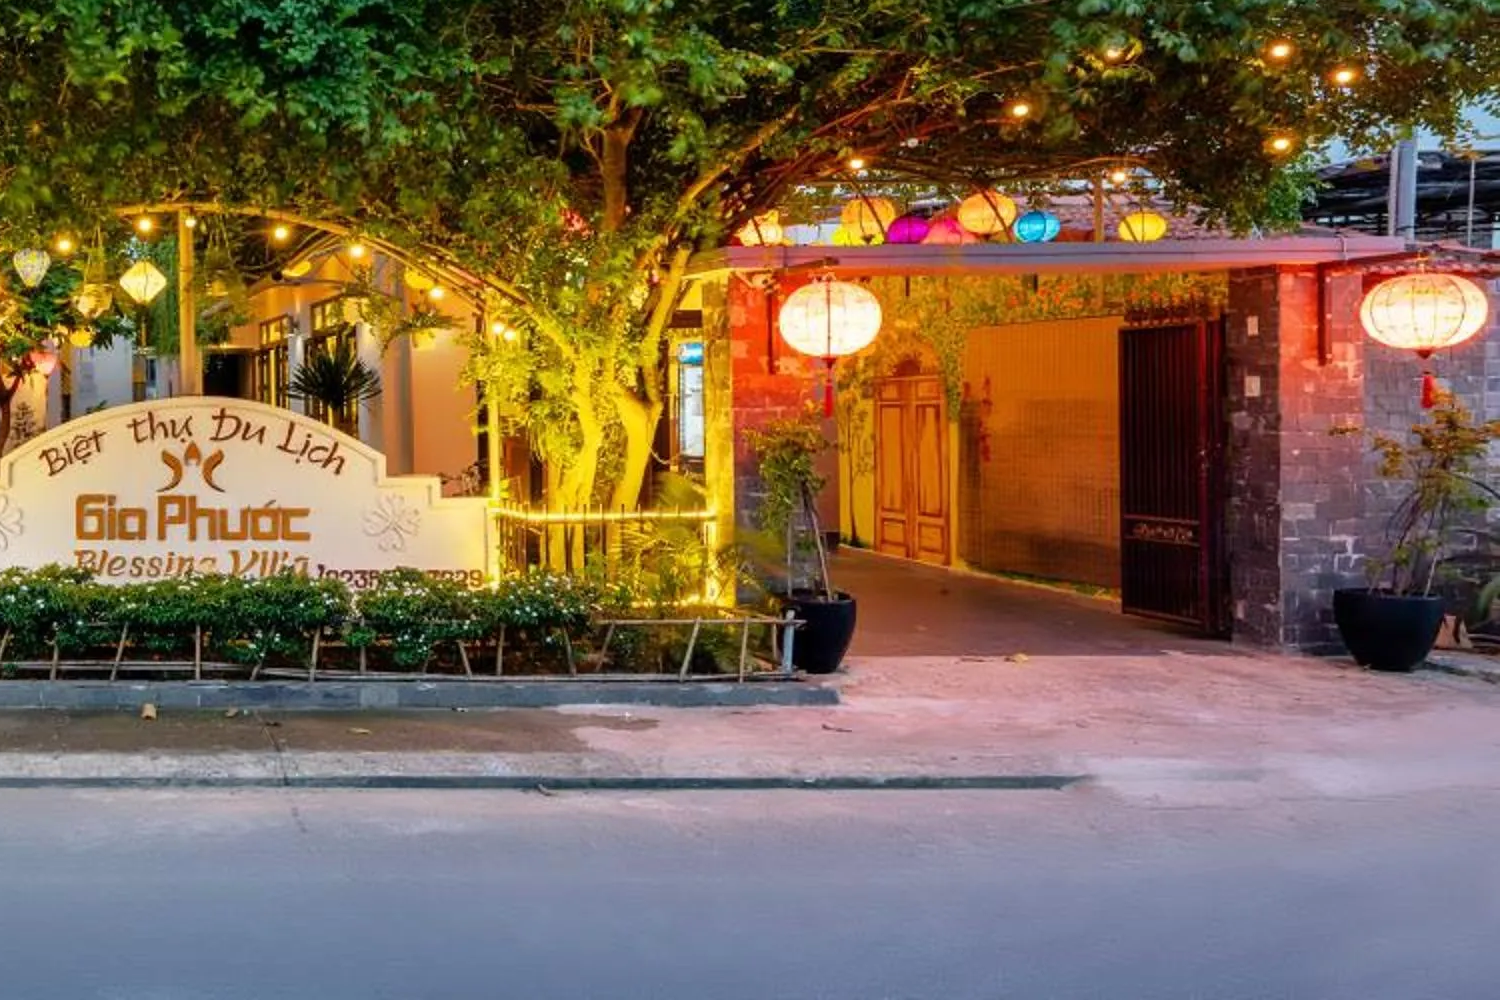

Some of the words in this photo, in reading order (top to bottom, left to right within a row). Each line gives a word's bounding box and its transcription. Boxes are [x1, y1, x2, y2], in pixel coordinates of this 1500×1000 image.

[39, 431, 107, 476] Biệt
[209, 408, 264, 444] Du
[277, 421, 345, 475] Lịch
[76, 494, 147, 541] Gia
